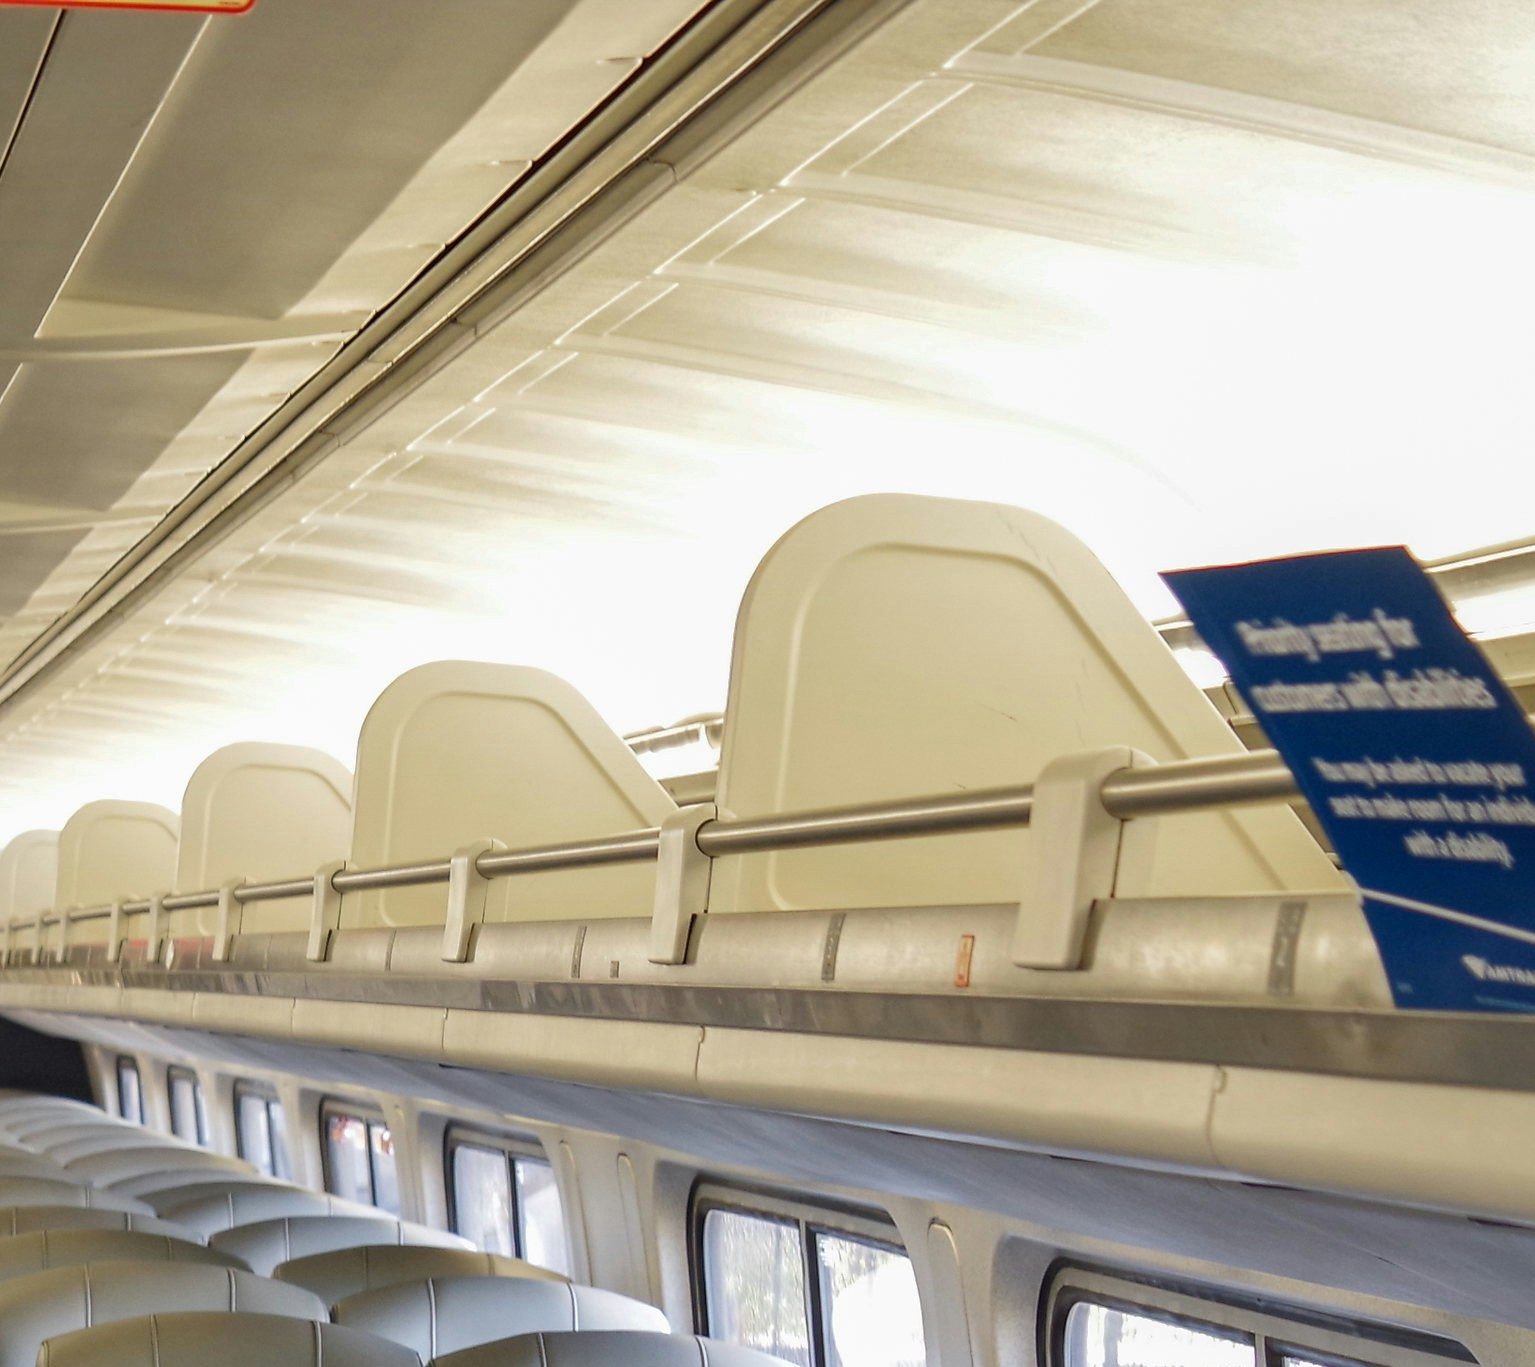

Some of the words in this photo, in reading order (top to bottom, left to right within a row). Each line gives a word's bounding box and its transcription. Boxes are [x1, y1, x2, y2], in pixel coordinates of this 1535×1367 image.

[1233, 617, 1321, 662] Priority
[1308, 611, 1394, 659] seating
[1371, 608, 1421, 648] for
[1248, 679, 1353, 713] customers
[1339, 670, 1392, 710] with
[1382, 667, 1498, 709] disabilities
[1340, 761, 1376, 788] may
[1364, 755, 1392, 783] be
[1425, 760, 1449, 784] to
[1487, 763, 1526, 792] your
[1404, 829, 1438, 858] with
